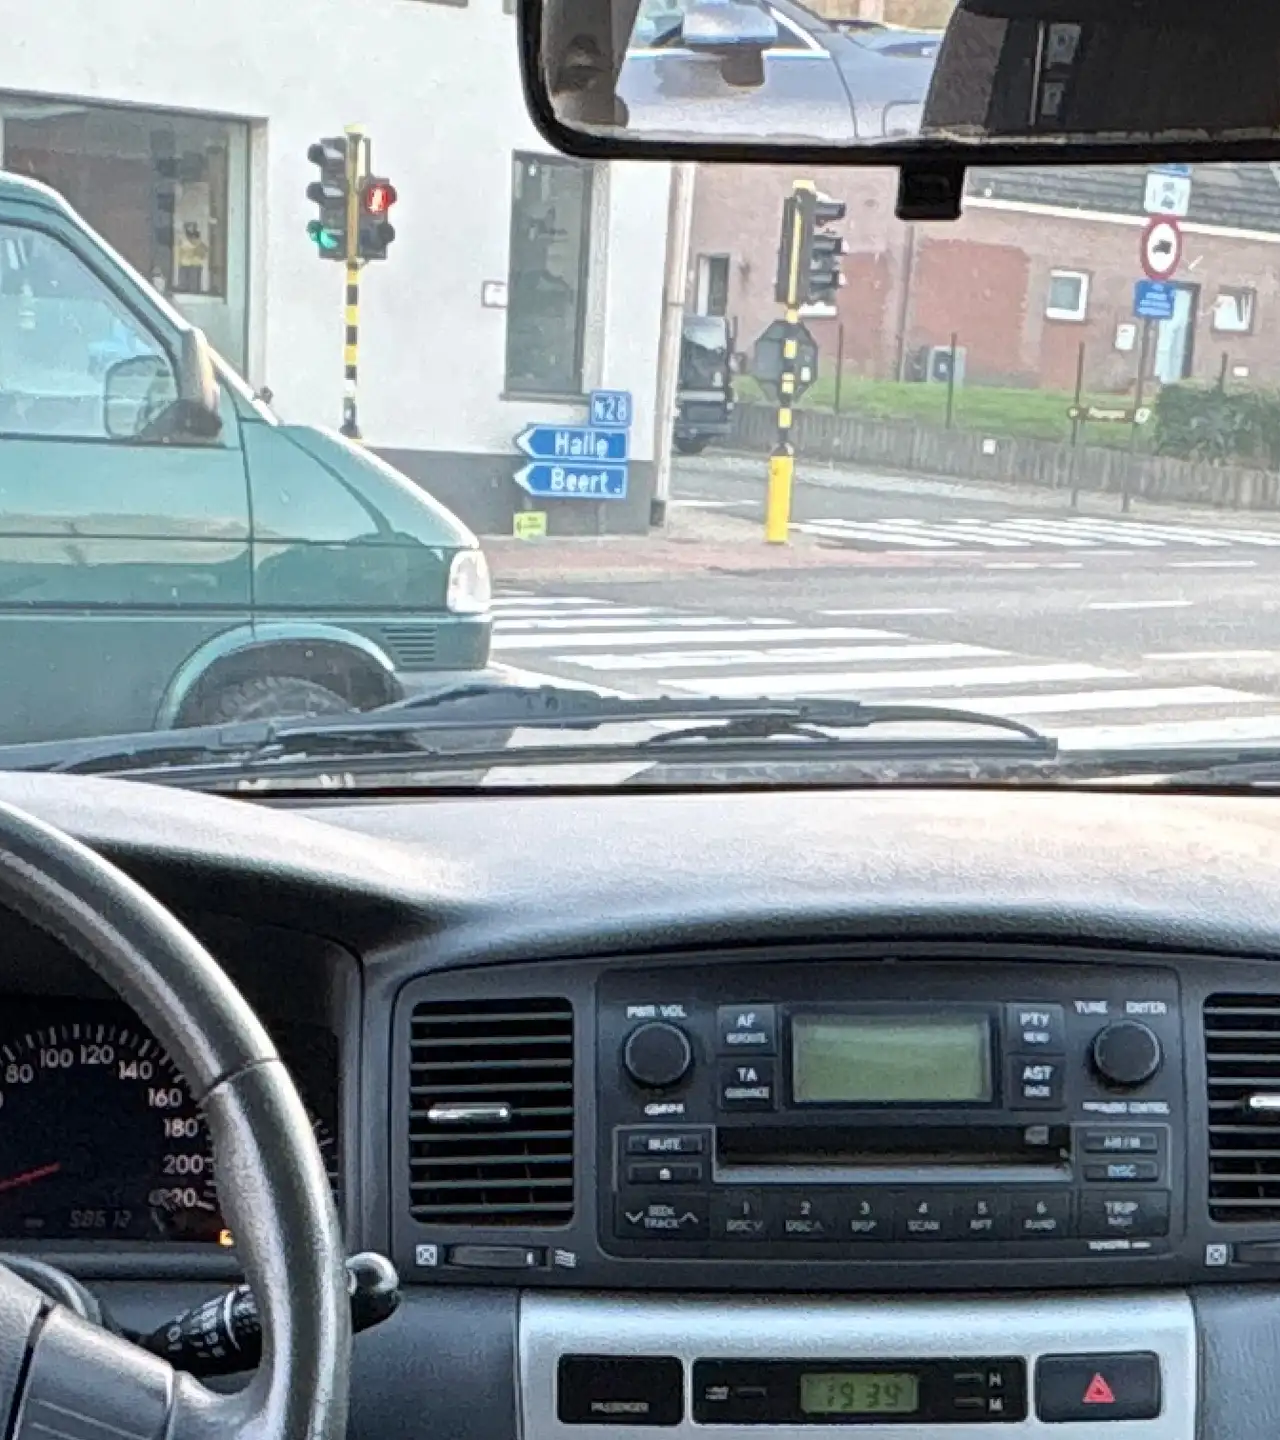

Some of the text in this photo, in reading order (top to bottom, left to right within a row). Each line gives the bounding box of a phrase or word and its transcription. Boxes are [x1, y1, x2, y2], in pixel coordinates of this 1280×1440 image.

[555, 431, 609, 458] Halle
[551, 467, 609, 494] Beert
[1073, 1000, 1108, 1015] TUNE
[1020, 1011, 1050, 1028] PTY
[40, 1048, 74, 1069] 100
[80, 1045, 114, 1065] 120
[5, 1063, 34, 1084] 80
[119, 1060, 153, 1080] 140
[736, 1066, 758, 1082] TA
[1023, 1065, 1053, 1081] AST
[148, 1088, 183, 1108] 160
[163, 1118, 199, 1138] 180
[163, 1154, 204, 1174] 200
[800, 1200, 812, 1215] 2
